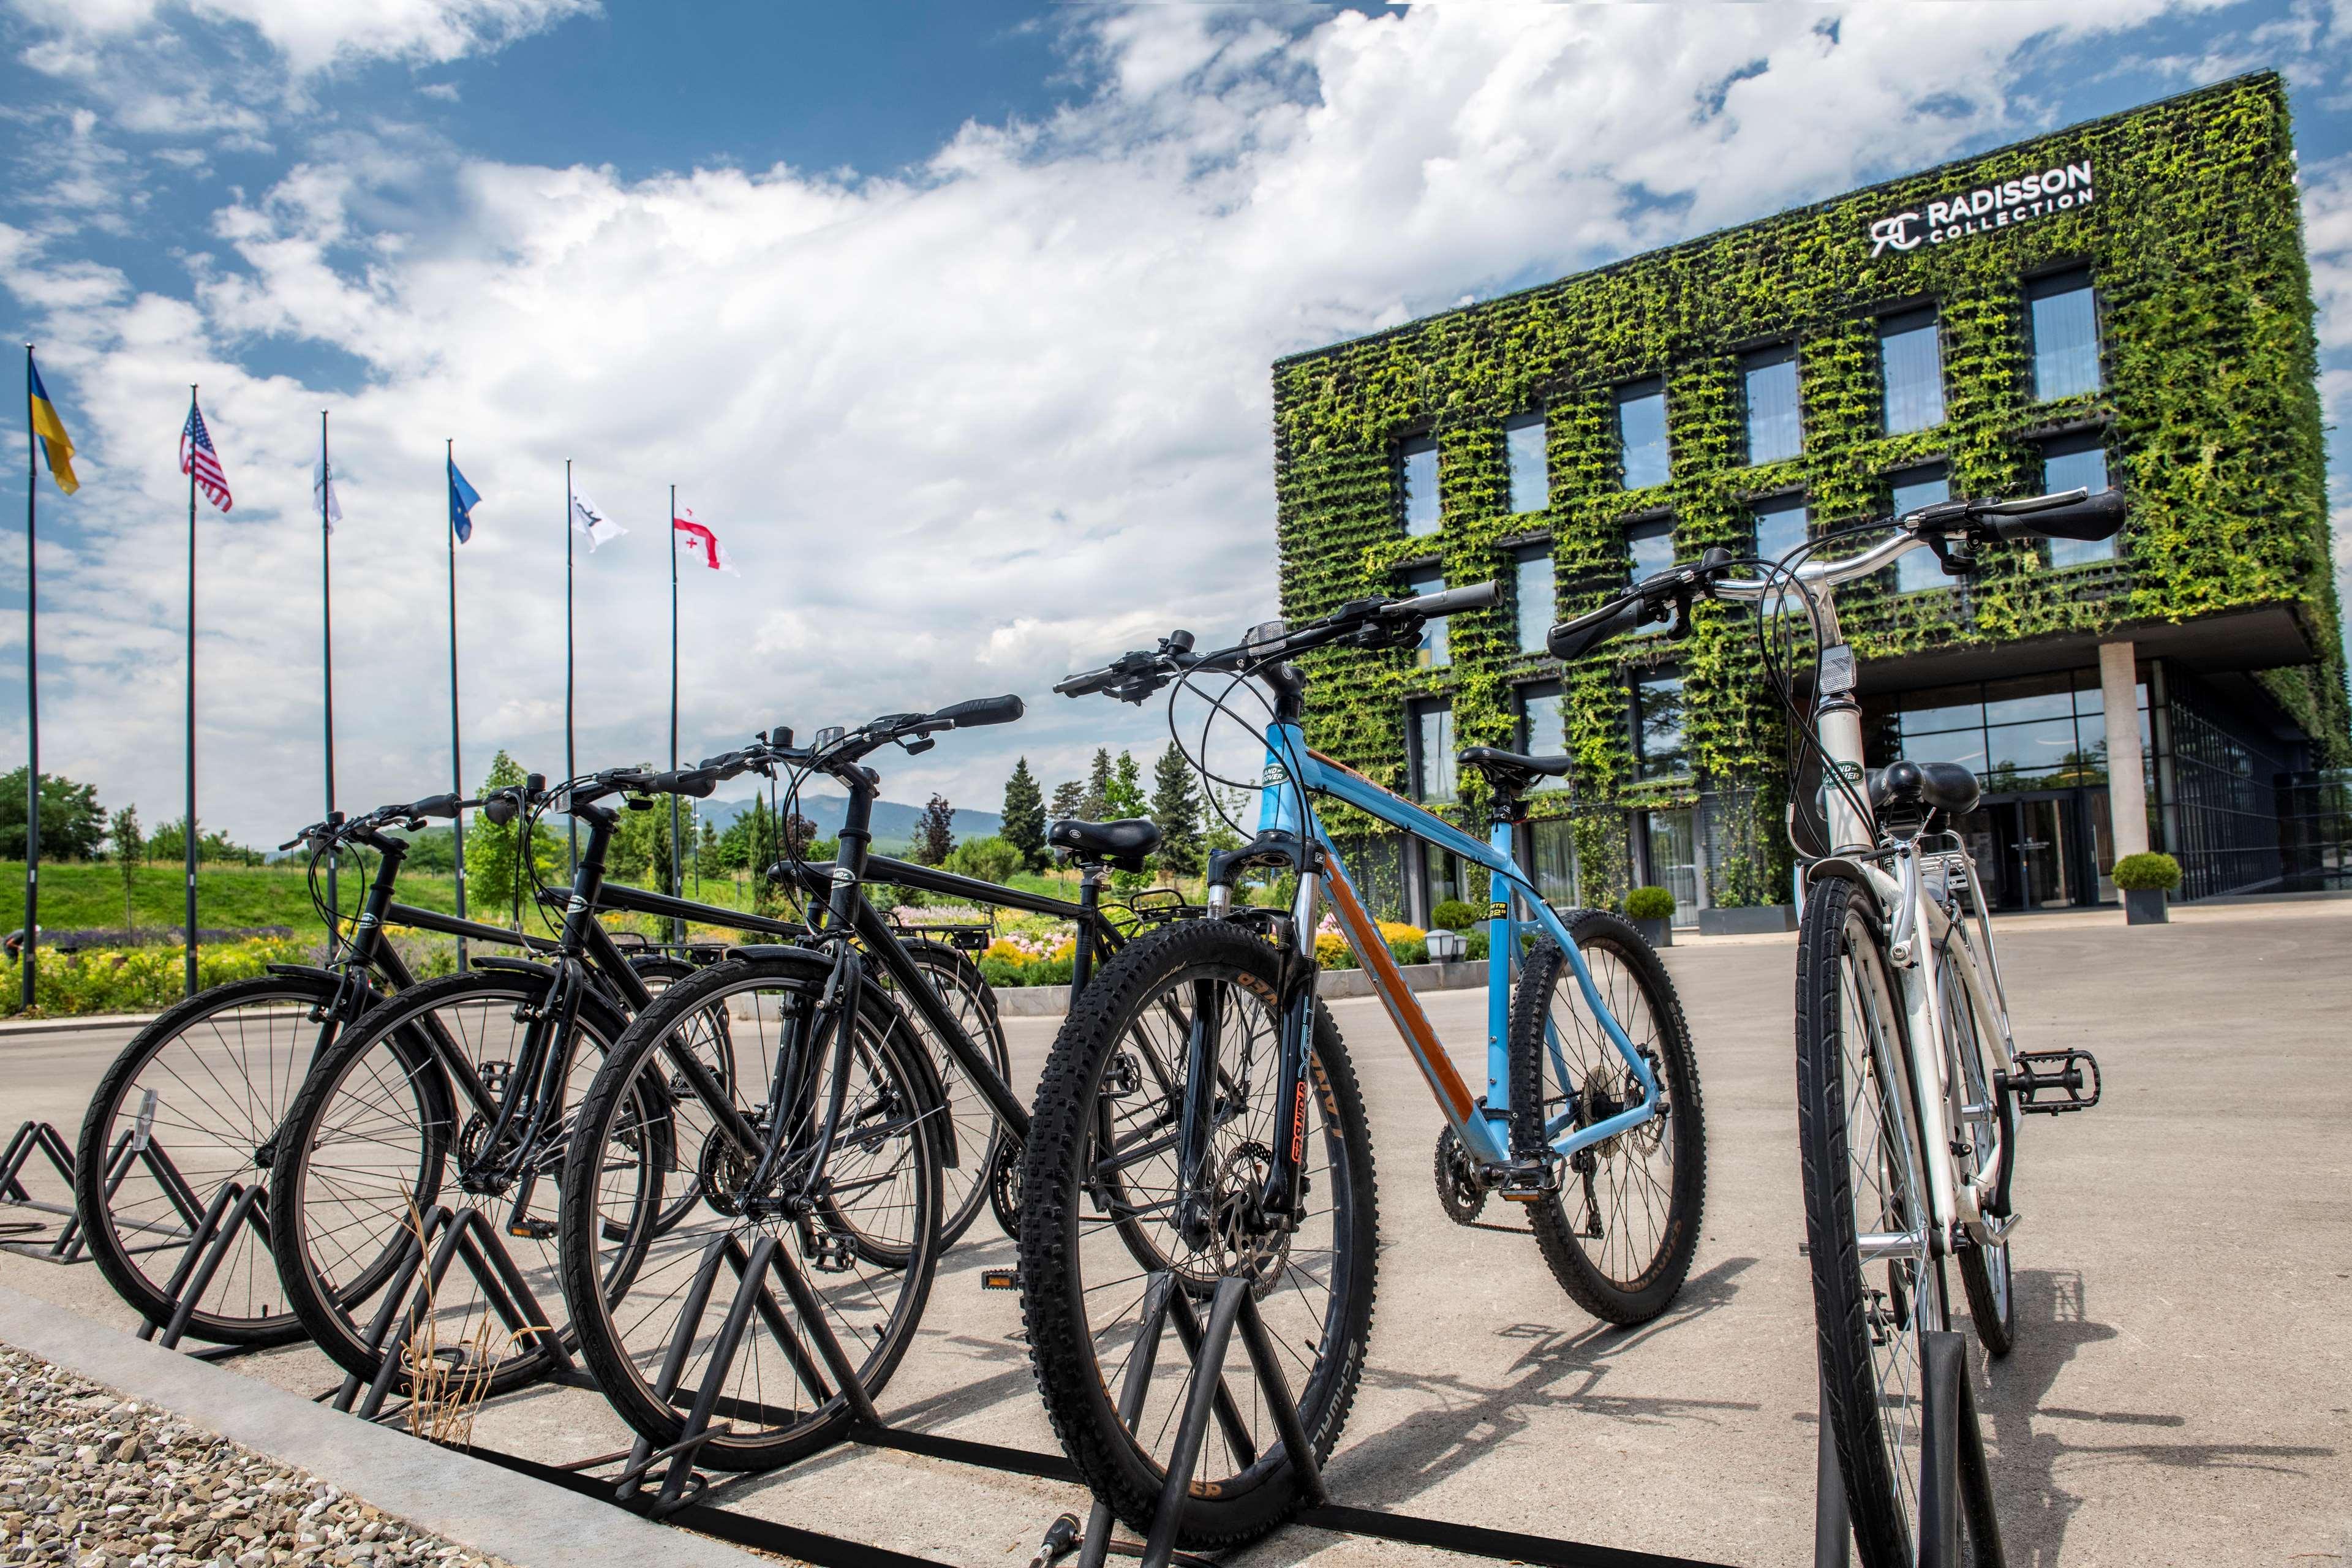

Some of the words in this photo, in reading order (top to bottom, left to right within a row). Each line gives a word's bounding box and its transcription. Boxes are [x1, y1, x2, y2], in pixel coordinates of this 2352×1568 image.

[1928, 160, 2092, 228] RADISSON
[1929, 188, 2094, 244] COLLECTION
[1668, 1001, 1698, 1108] SCHWALBE
